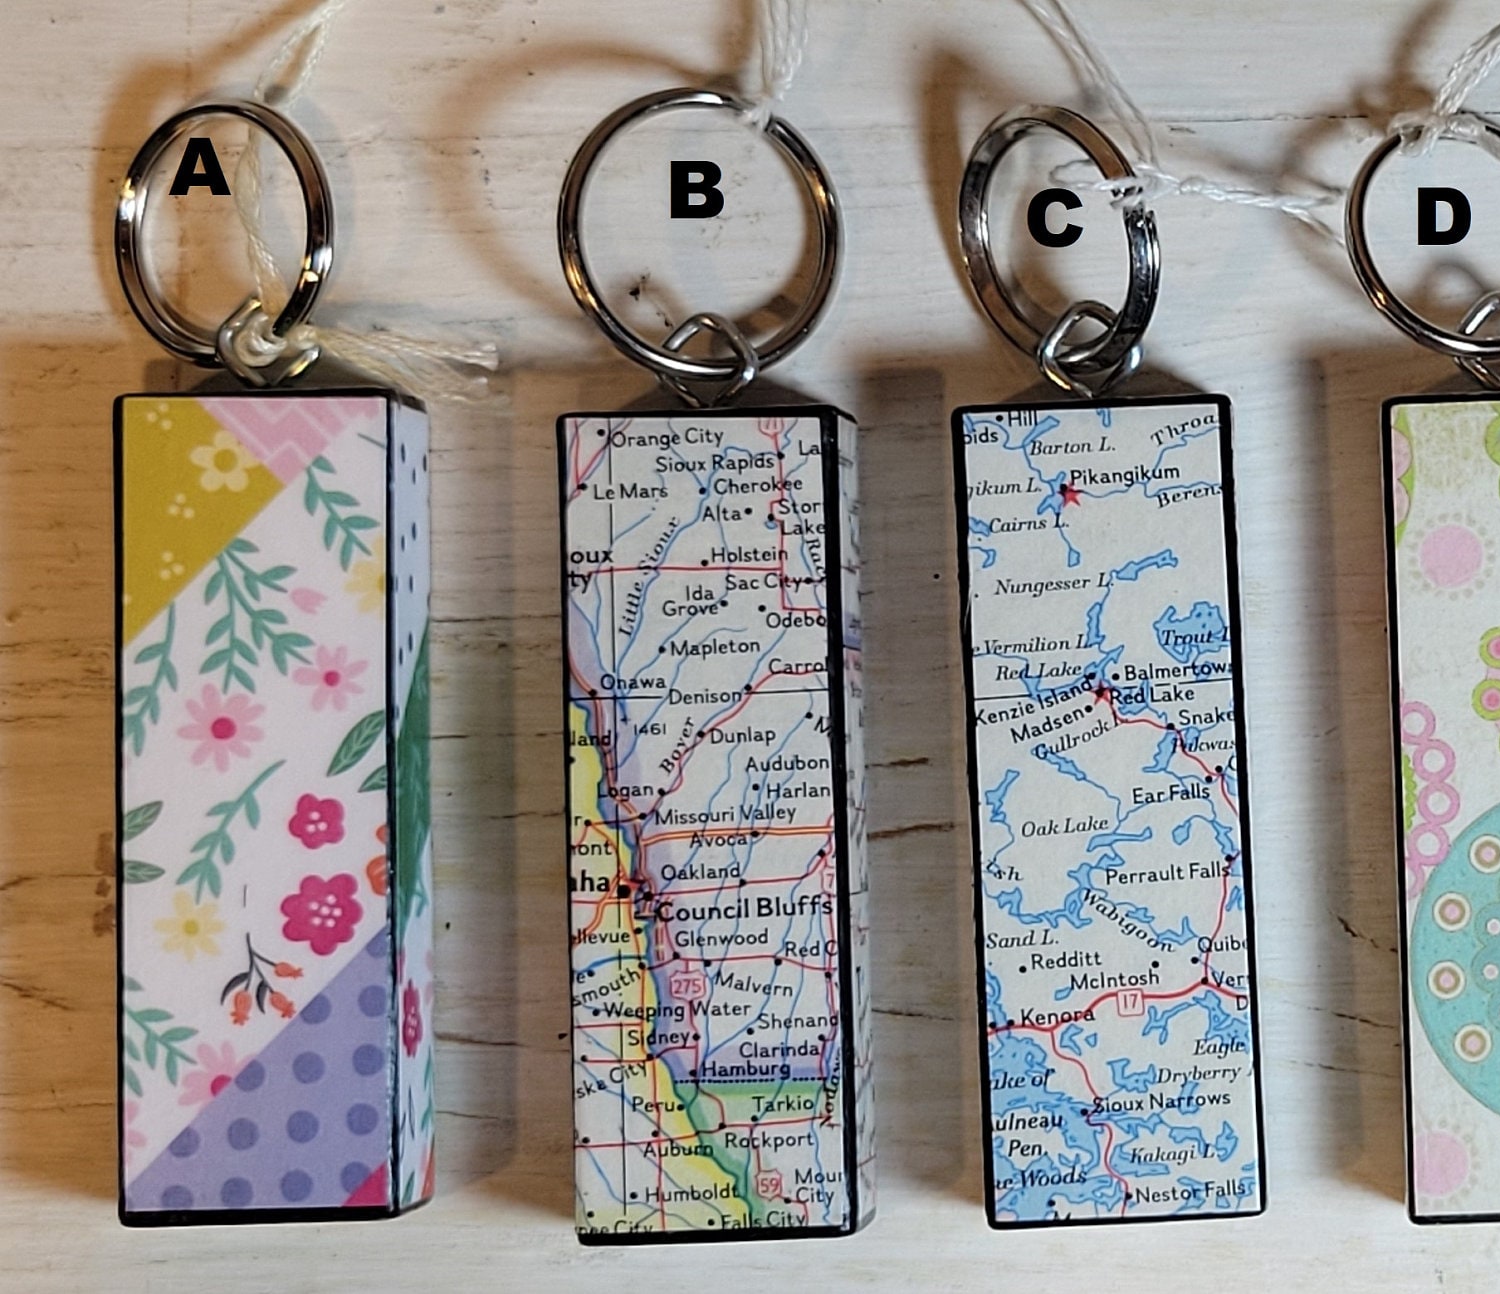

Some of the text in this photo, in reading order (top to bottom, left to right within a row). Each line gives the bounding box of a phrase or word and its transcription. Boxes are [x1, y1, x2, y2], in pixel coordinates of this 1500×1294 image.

[610, 427, 724, 448] Orange City
[1030, 441, 1091, 456] Barton
[656, 455, 774, 474] Sioux Rapids
[1070, 464, 1180, 487] Pikangikum
[594, 484, 668, 500] Le Mars
[714, 477, 803, 495] Cherokee
[703, 507, 742, 522] Alta
[781, 519, 826, 535] Lake
[990, 516, 1046, 533] Cairns
[712, 547, 788, 563] Holstein
[726, 573, 801, 592] Sac City
[995, 576, 1090, 597] Nungesser
[686, 585, 714, 600] Ida
[663, 600, 719, 617] Grove
[984, 637, 1071, 655] Vermilion
[1162, 629, 1214, 646] Trout
[671, 638, 760, 660] Mapleton
[1035, 663, 1082, 678] Lake
[600, 674, 666, 690] Onawa
[669, 688, 742, 705] Denison
[1038, 674, 1094, 710] Island
[1110, 686, 1195, 705] Red Lake
[1011, 707, 1085, 744] Madsen
[710, 726, 776, 745] Dunlap
[1032, 721, 1111, 760] Gullrock
[658, 716, 695, 776] Boyer
[746, 754, 829, 772] Audubon
[766, 783, 830, 798] Harlan
[1132, 784, 1211, 804] Ear Falls
[655, 804, 796, 825] Missouri Valley
[1021, 817, 1109, 837] Oak Lake
[690, 831, 748, 848] Avoca
[661, 864, 740, 881] Oakland
[1106, 861, 1230, 886] Perrault Falls
[656, 895, 833, 922] Council Bluffs
[1082, 886, 1175, 953] Wabigoon
[676, 930, 768, 947] Glenwood
[986, 929, 1035, 949] Sand
[785, 940, 819, 957] Red
[1031, 951, 1102, 969] Redditt
[674, 979, 701, 994] 275
[714, 972, 793, 997] Malvern
[1123, 993, 1139, 1010] 17
[604, 1002, 751, 1021] Weeping Water
[1021, 1008, 1095, 1025] Kenora
[628, 1030, 689, 1049] Sidney
[740, 1040, 818, 1059] Clarinda
[702, 1061, 790, 1079] Hamburg
[1157, 1064, 1242, 1089] Dryberry
[631, 1097, 676, 1113] Peru
[752, 1095, 814, 1112] Tarkio
[1093, 1092, 1231, 1114] Sioux Narrows
[644, 1143, 713, 1158] Auburn
[725, 1133, 814, 1151] Rockport
[1130, 1147, 1195, 1166] Kakagi
[760, 1179, 779, 1192] 59
[1020, 1166, 1087, 1188] Woods
[645, 1185, 740, 1203] Humboldt
[796, 1189, 834, 1208] City
[1136, 1180, 1245, 1204] Nestor Falls
